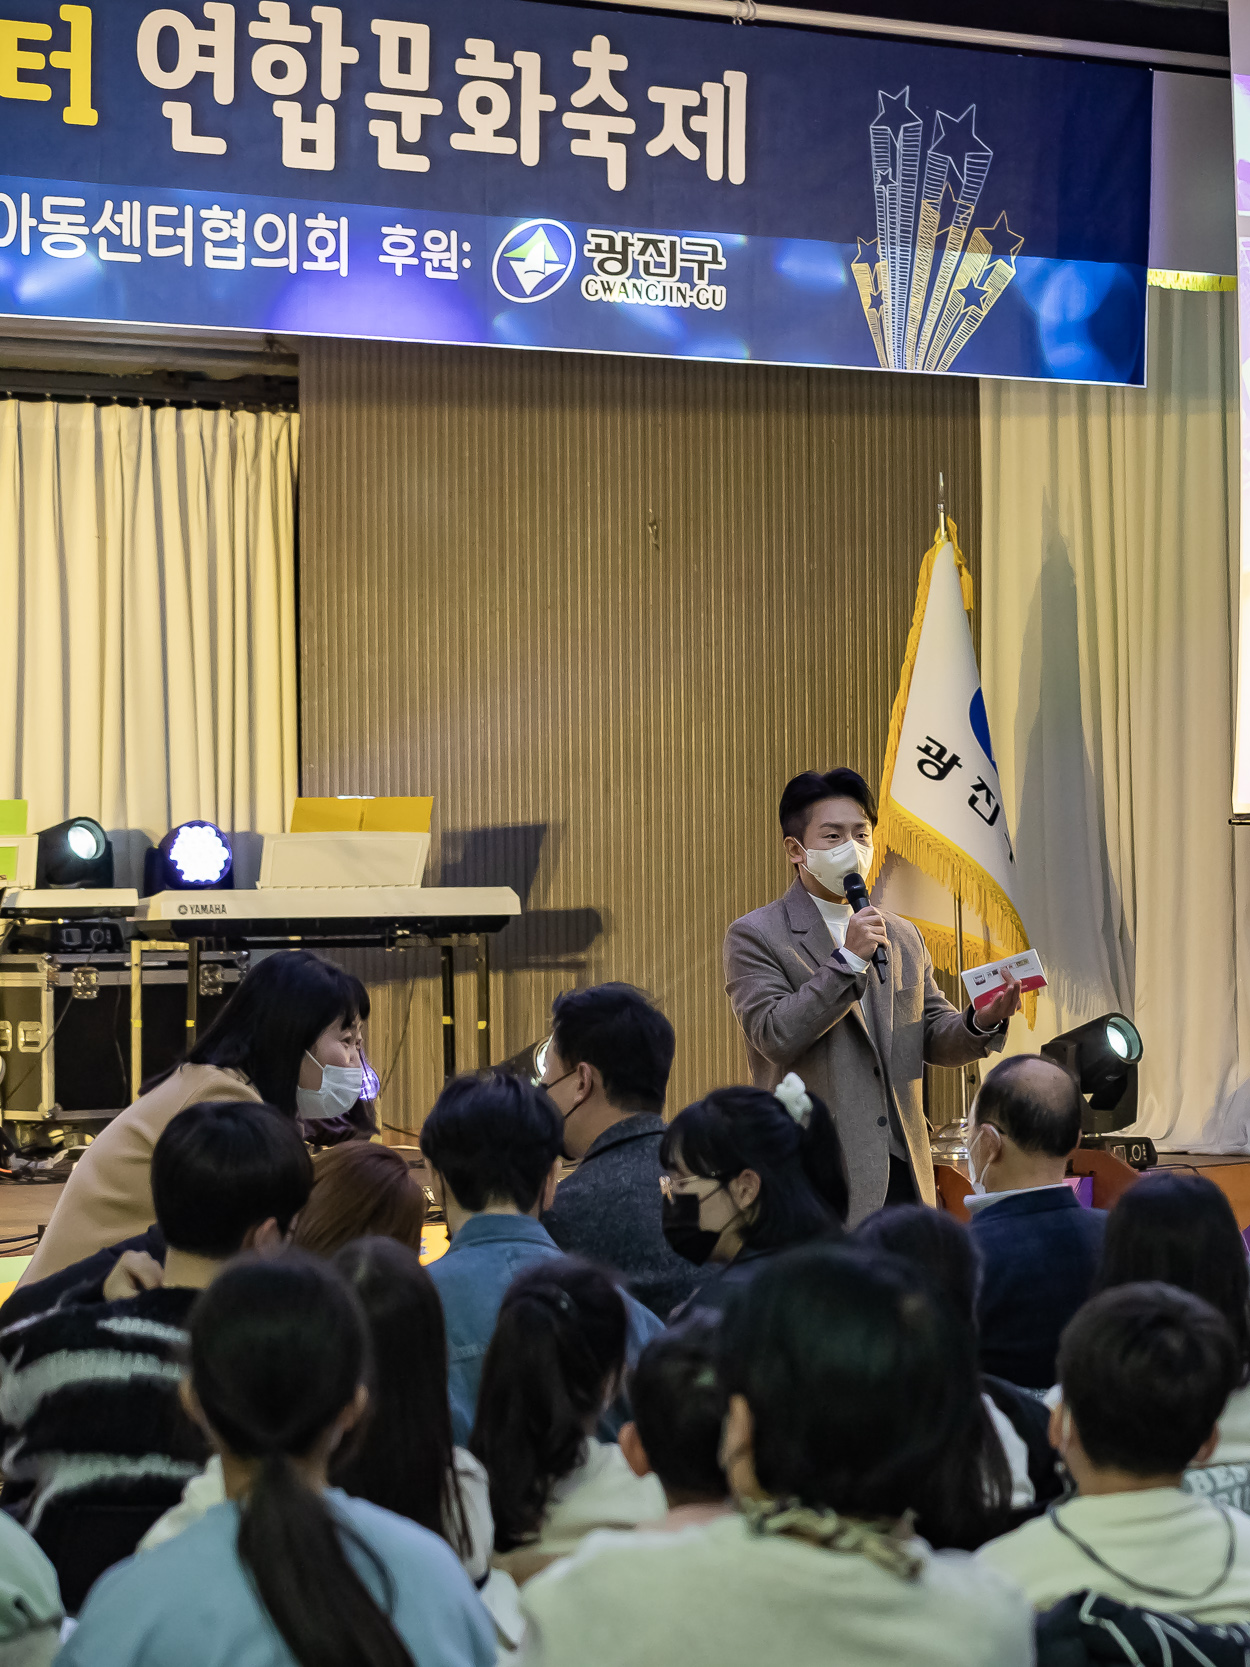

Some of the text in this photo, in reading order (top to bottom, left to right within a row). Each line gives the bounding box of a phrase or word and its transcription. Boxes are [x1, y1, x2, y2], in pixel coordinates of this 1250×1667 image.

[0, 1, 748, 192] 터 연합문화축제
[0, 192, 472, 280] 아동센터협의회 후원:
[585, 229, 726, 284] 광진구
[583, 277, 725, 309] GWANGJIN-GU
[189, 904, 227, 915] YAMAHA
